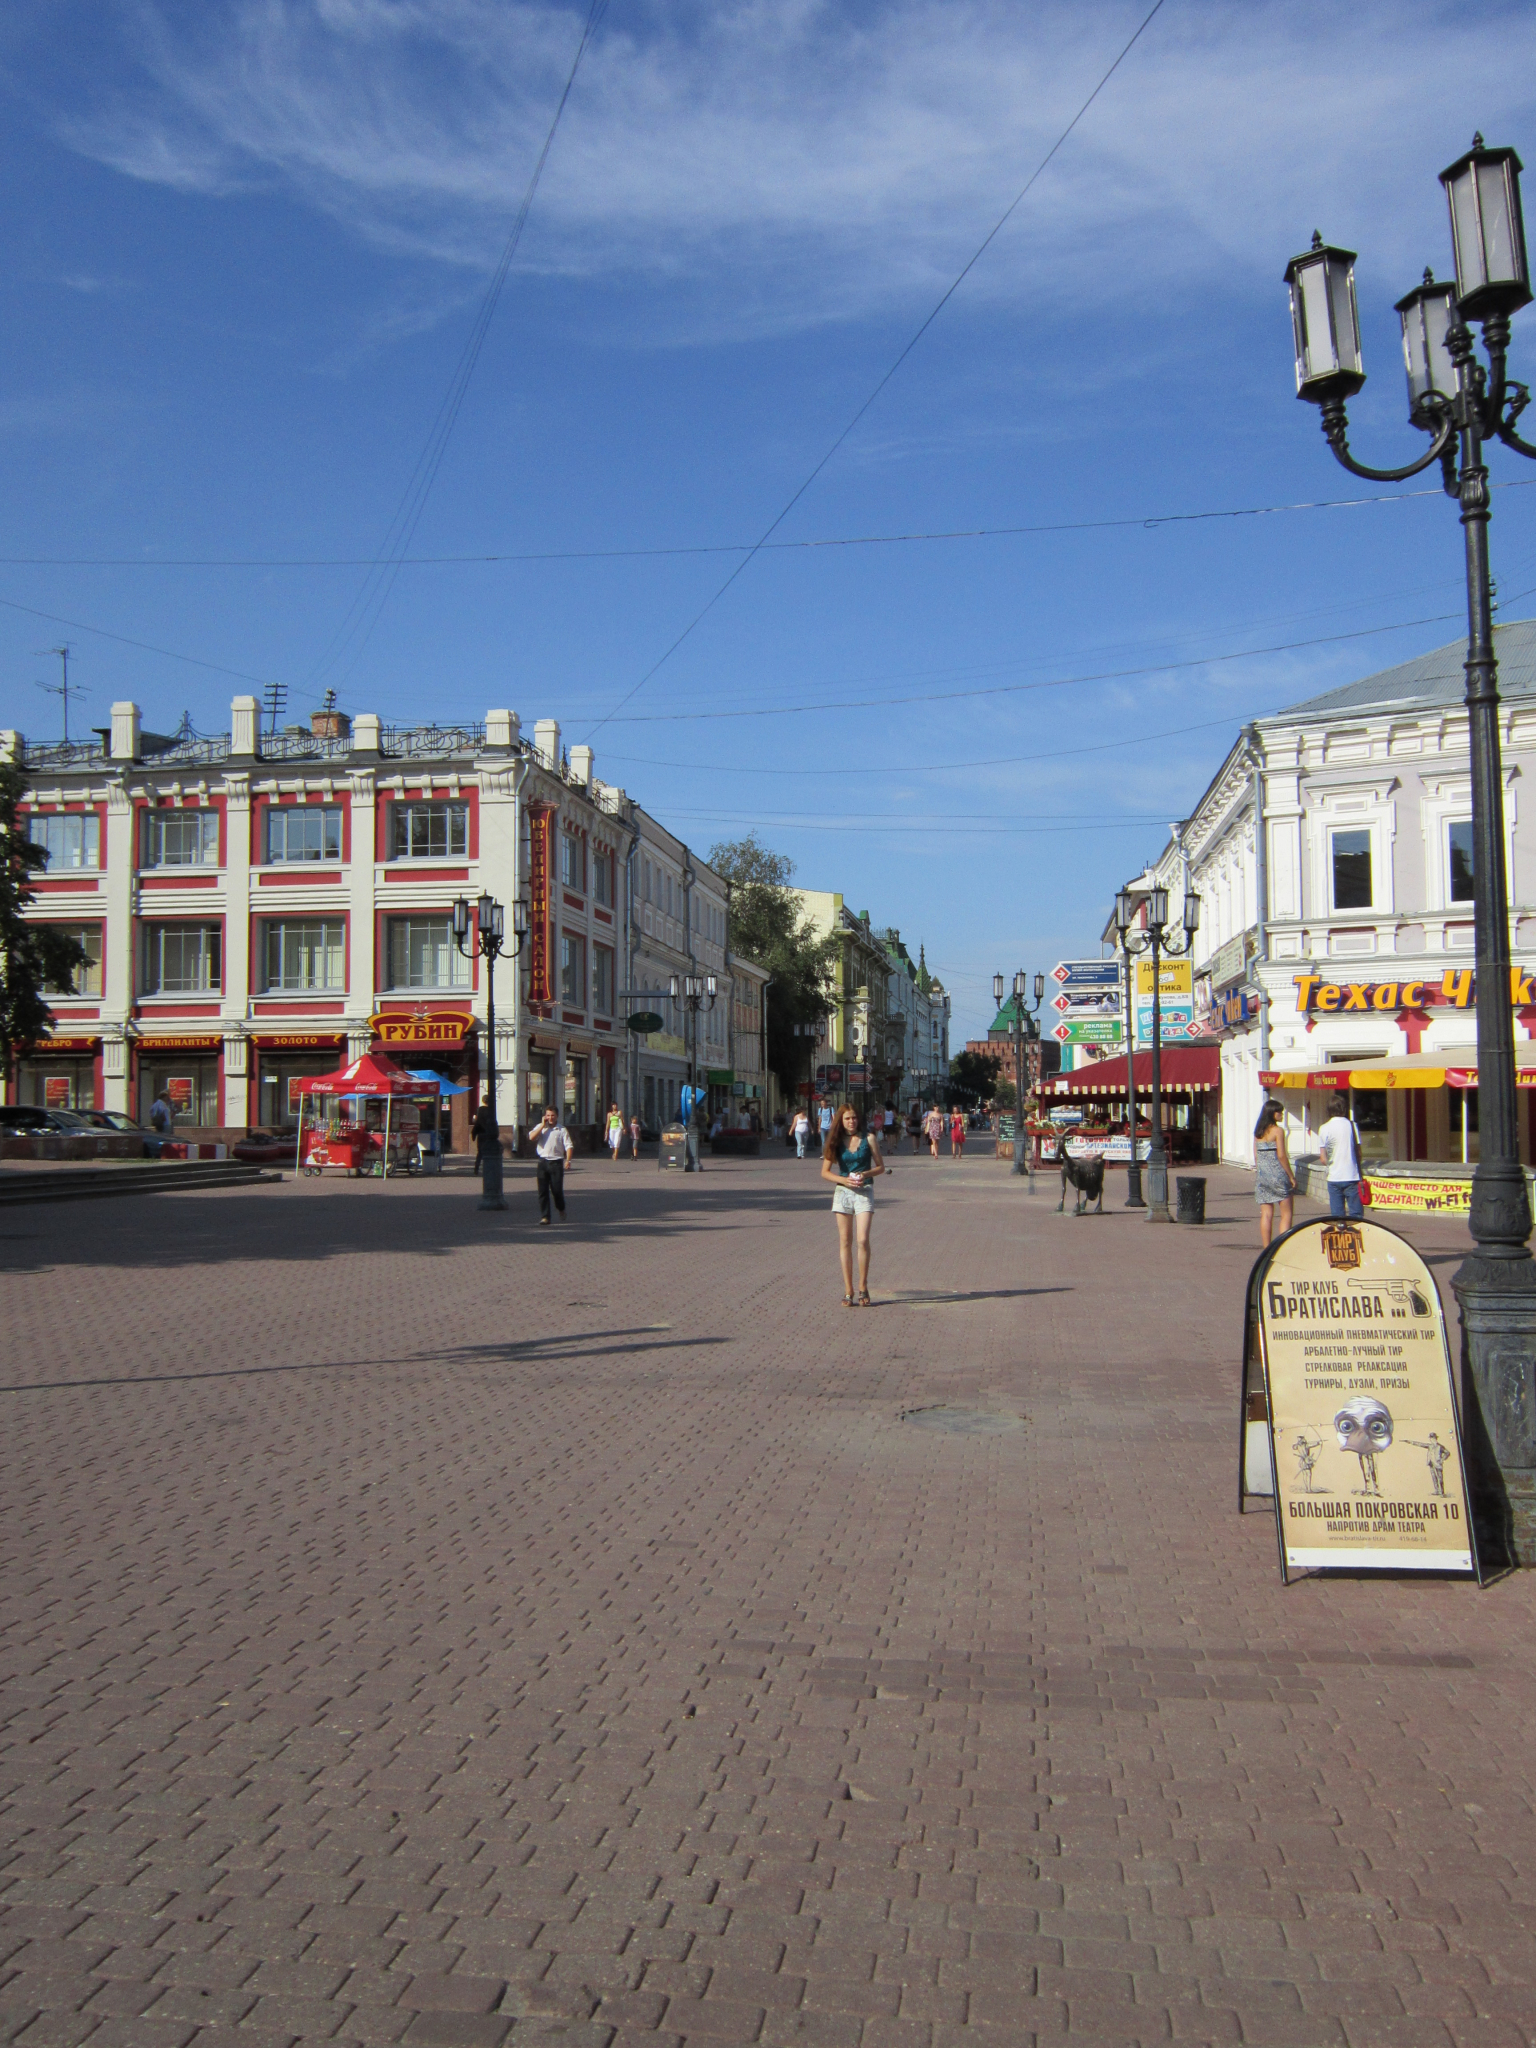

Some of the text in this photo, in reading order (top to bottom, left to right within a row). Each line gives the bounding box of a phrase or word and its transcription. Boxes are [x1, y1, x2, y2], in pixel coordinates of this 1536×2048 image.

[1147, 984, 1182, 992] отика
[1292, 966, 1536, 1012] Техас Чк
[386, 1024, 459, 1041] РУБИН
[142, 1038, 211, 1048] БРИЛЛИАНТЫ
[272, 1036, 318, 1045] ЗОЛОТО
[1404, 1183, 1438, 1192] место
[1441, 1185, 1462, 1194] для
[1330, 1233, 1353, 1249] ТИР
[1331, 1248, 1356, 1262] КЛУБ
[1289, 1280, 1339, 1296] ТИР КЛУБ
[1272, 1328, 1435, 1342] ИННОВАЦИОННЫЙ ПНЕВМАТИЧЕСКИЙ ТИР
[1304, 1344, 1403, 1357] АРБАЛЕТНО-ЛУЧНЫЙ ТИР
[1304, 1361, 1408, 1373] СТРЕЛКОВАЯ РЕЛАКСАЦИЯ
[1380, 1378, 1410, 1390] ПРИЗЫ
[1288, 1501, 1460, 1520] БОЛЬШАЯ ПОКРОВСКАЯ 10
[1326, 1521, 1426, 1533] НАПРОТИВ ДРАМ ТЕАТРА
